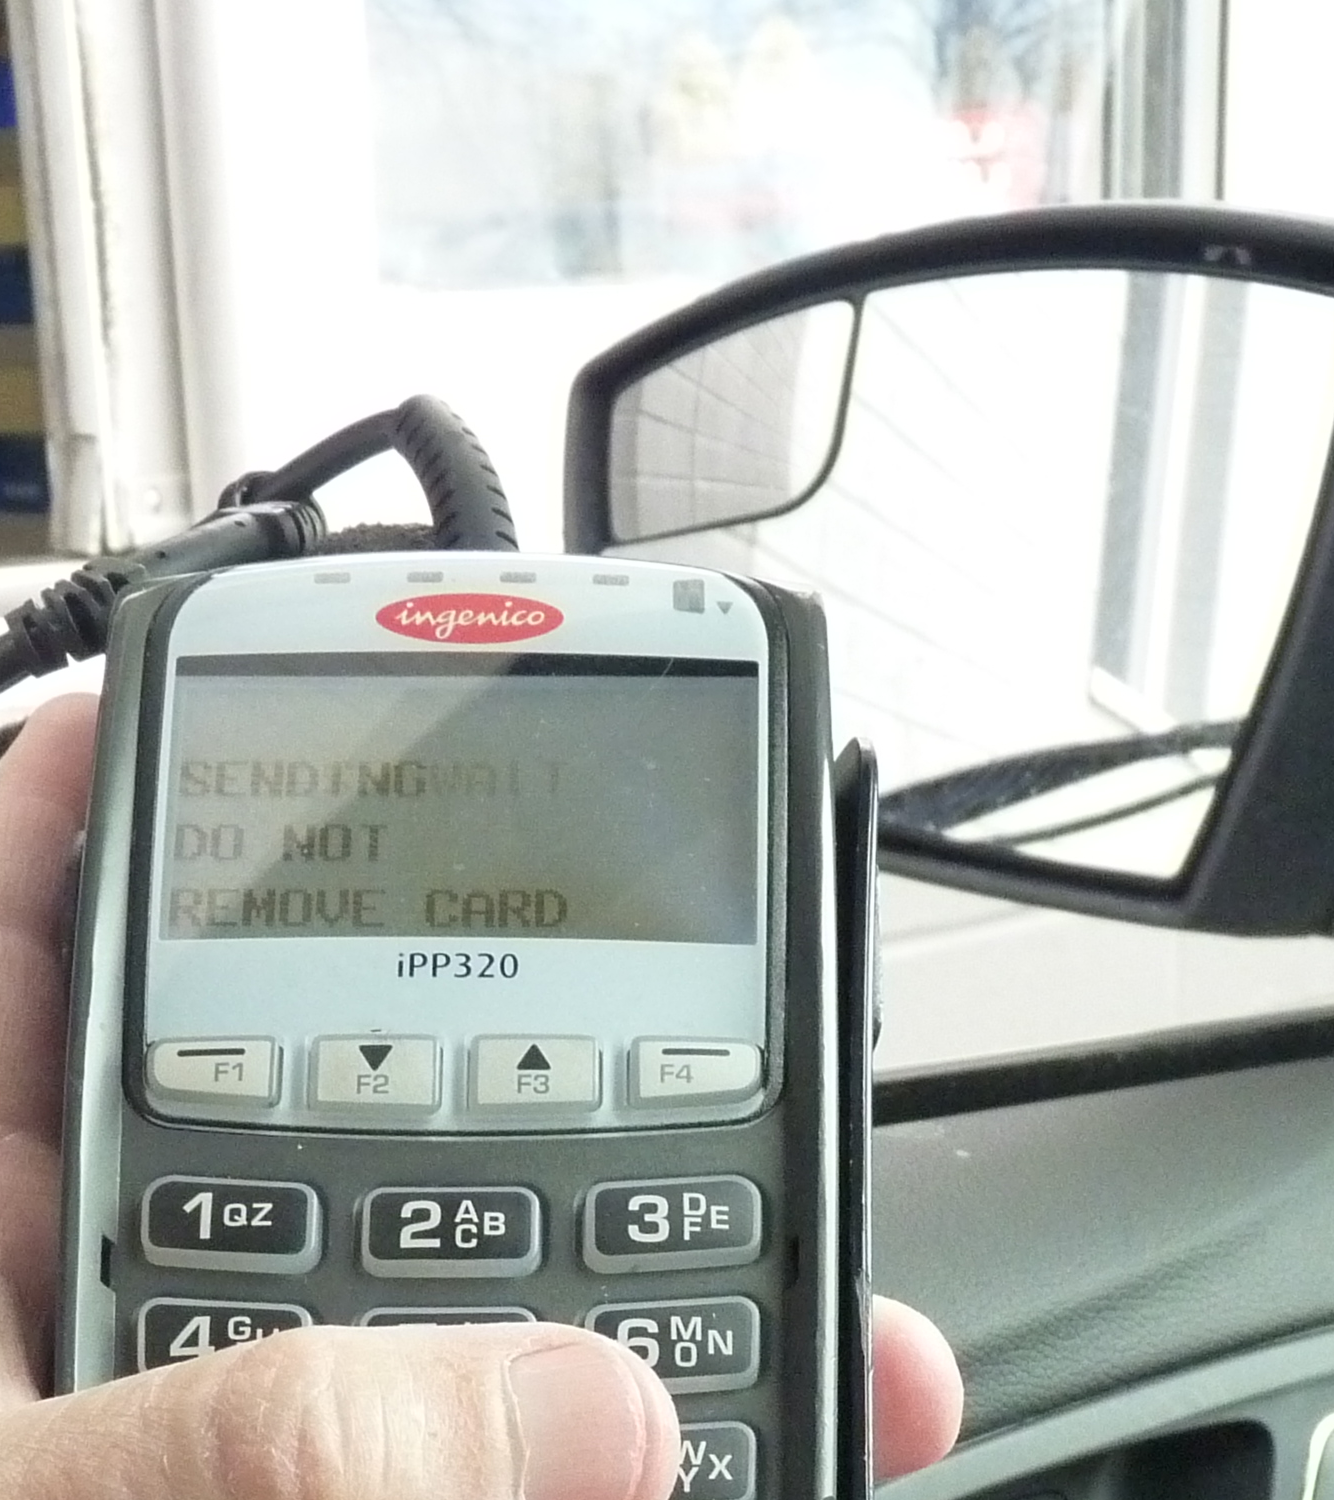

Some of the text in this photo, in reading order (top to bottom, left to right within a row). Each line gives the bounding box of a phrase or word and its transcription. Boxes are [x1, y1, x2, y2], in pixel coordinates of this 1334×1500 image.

[395, 601, 545, 640] ingenico
[174, 822, 388, 862] DO NOT
[169, 888, 568, 929] REMOVE CARD
[396, 951, 519, 980] iPP320
[213, 1062, 245, 1082] F1
[355, 1074, 389, 1095] F2
[515, 1074, 550, 1095] F3
[659, 1063, 694, 1084] F4
